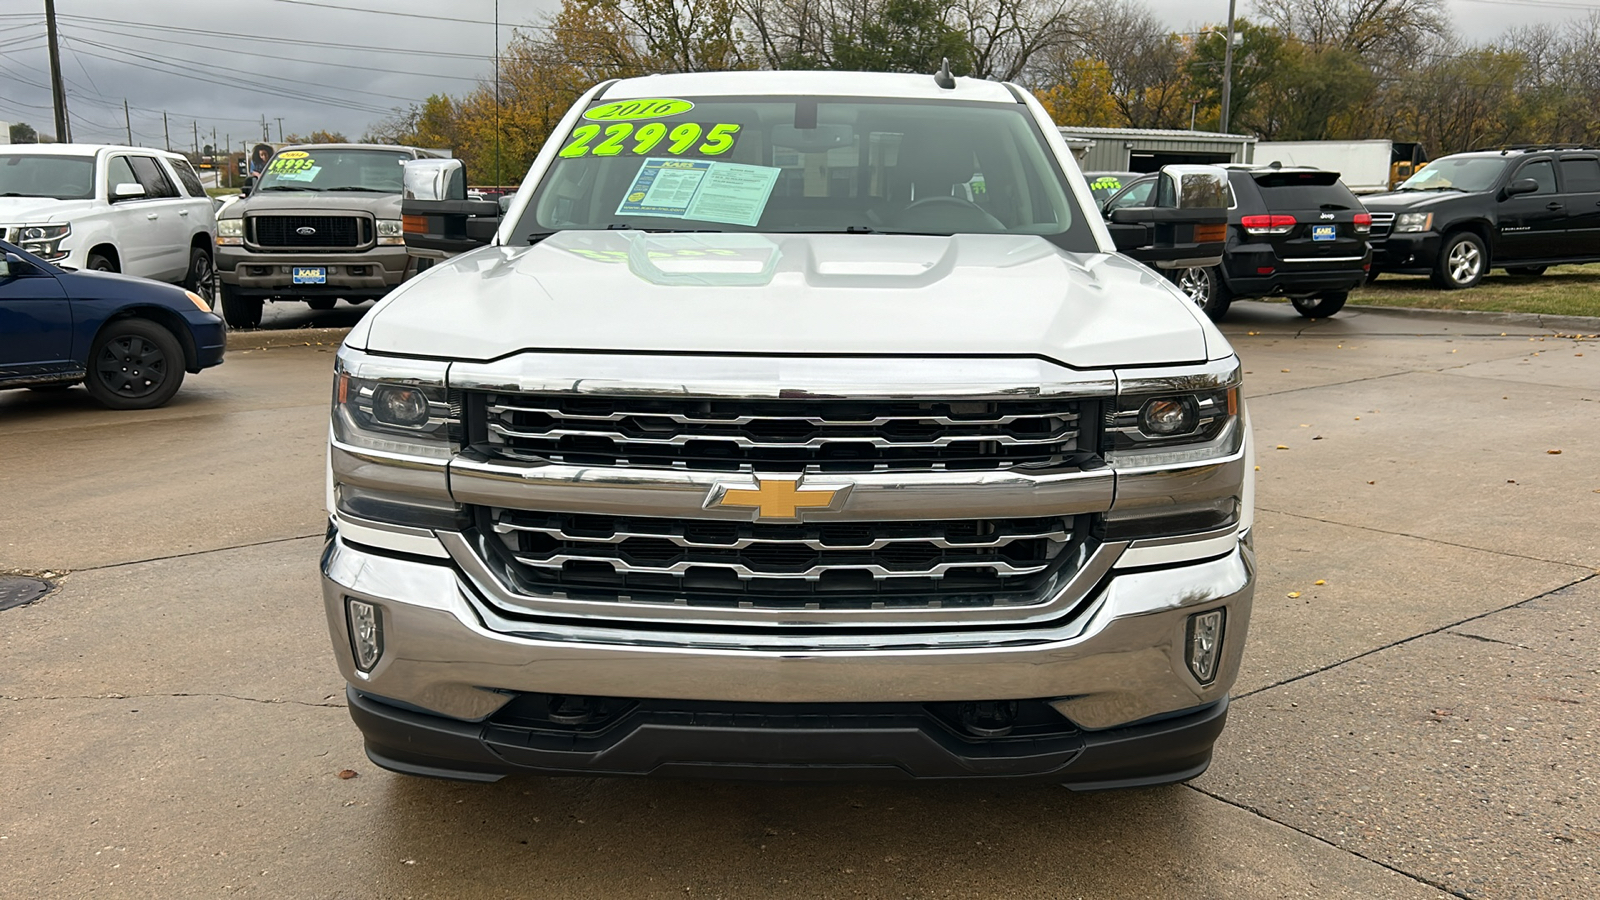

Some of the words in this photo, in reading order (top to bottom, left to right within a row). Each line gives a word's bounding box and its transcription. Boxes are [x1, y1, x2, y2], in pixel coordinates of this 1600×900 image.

[598, 101, 675, 119] 2016
[558, 122, 741, 158] 22995
[268, 158, 315, 170] 14995
[1320, 212, 1335, 220] Jeep
[298, 268, 321, 277] KARS
